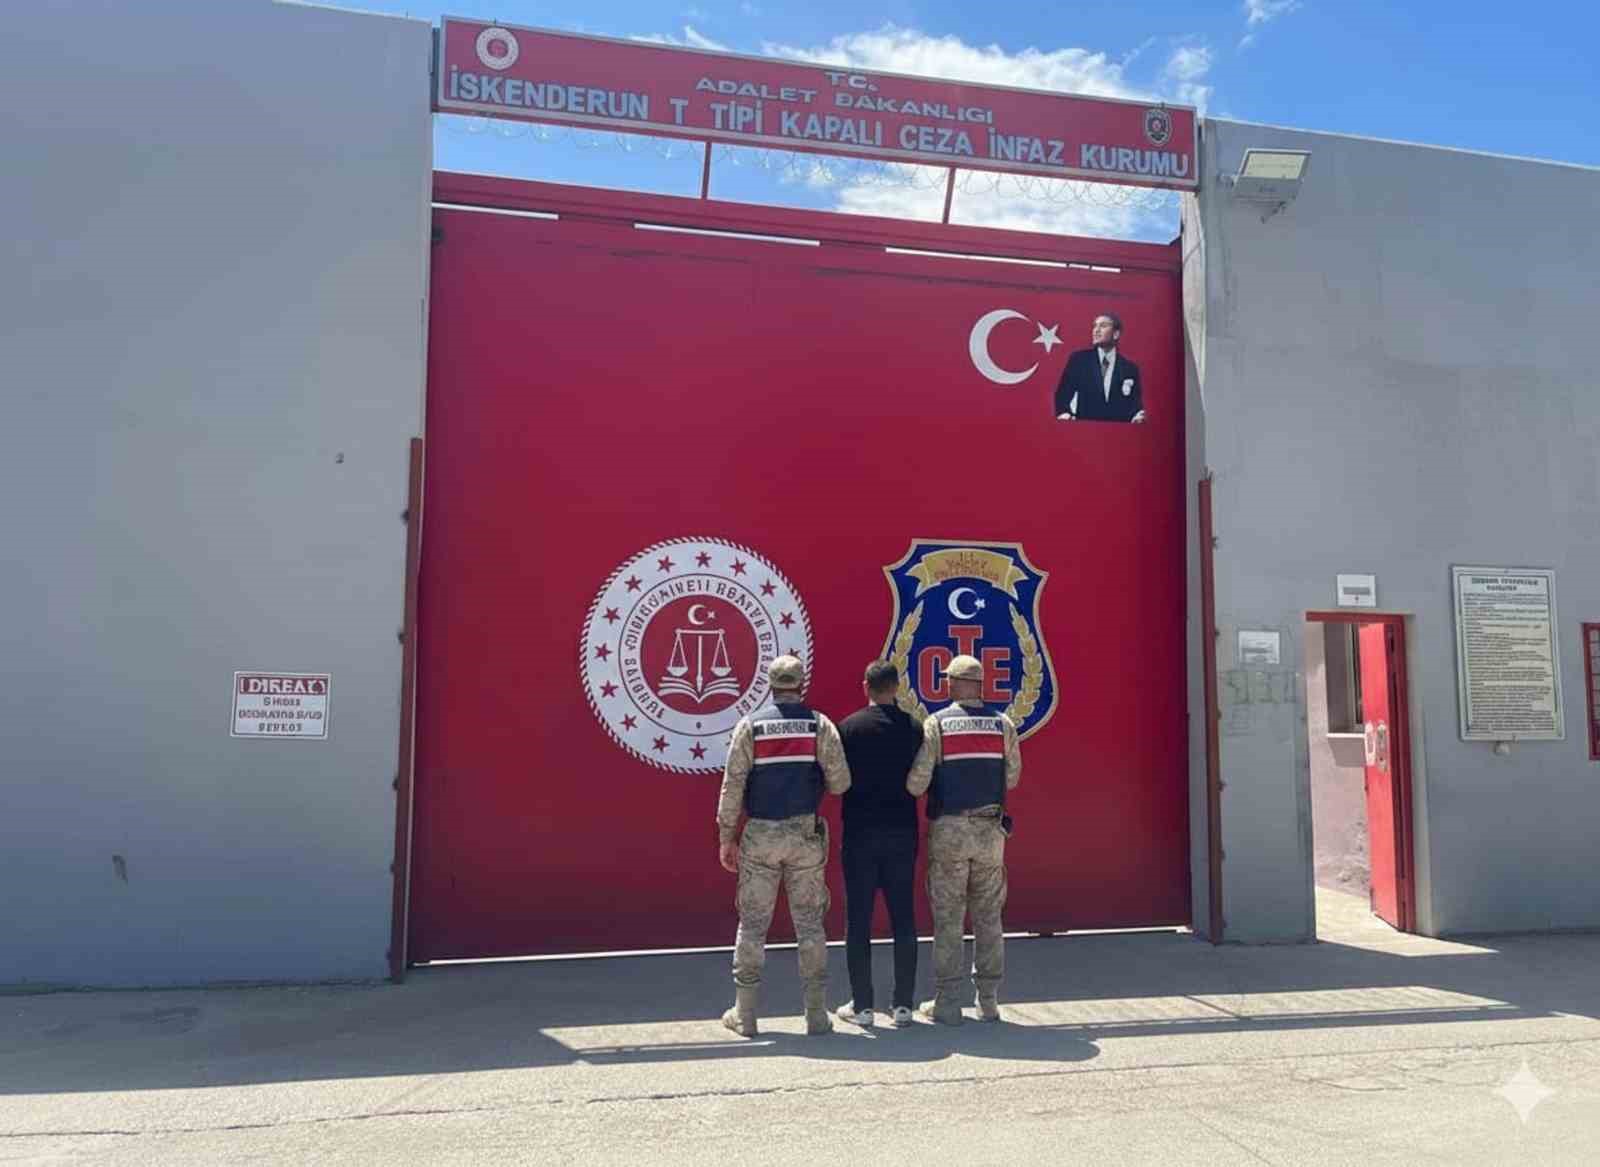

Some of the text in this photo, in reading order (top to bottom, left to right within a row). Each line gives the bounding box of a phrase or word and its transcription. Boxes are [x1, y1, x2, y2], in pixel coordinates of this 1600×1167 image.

[449, 65, 1189, 177] İSKENDERUN T TİPİ KAPALI CEZA İNFAZ KURUMU
[695, 77, 817, 103] ADALET
